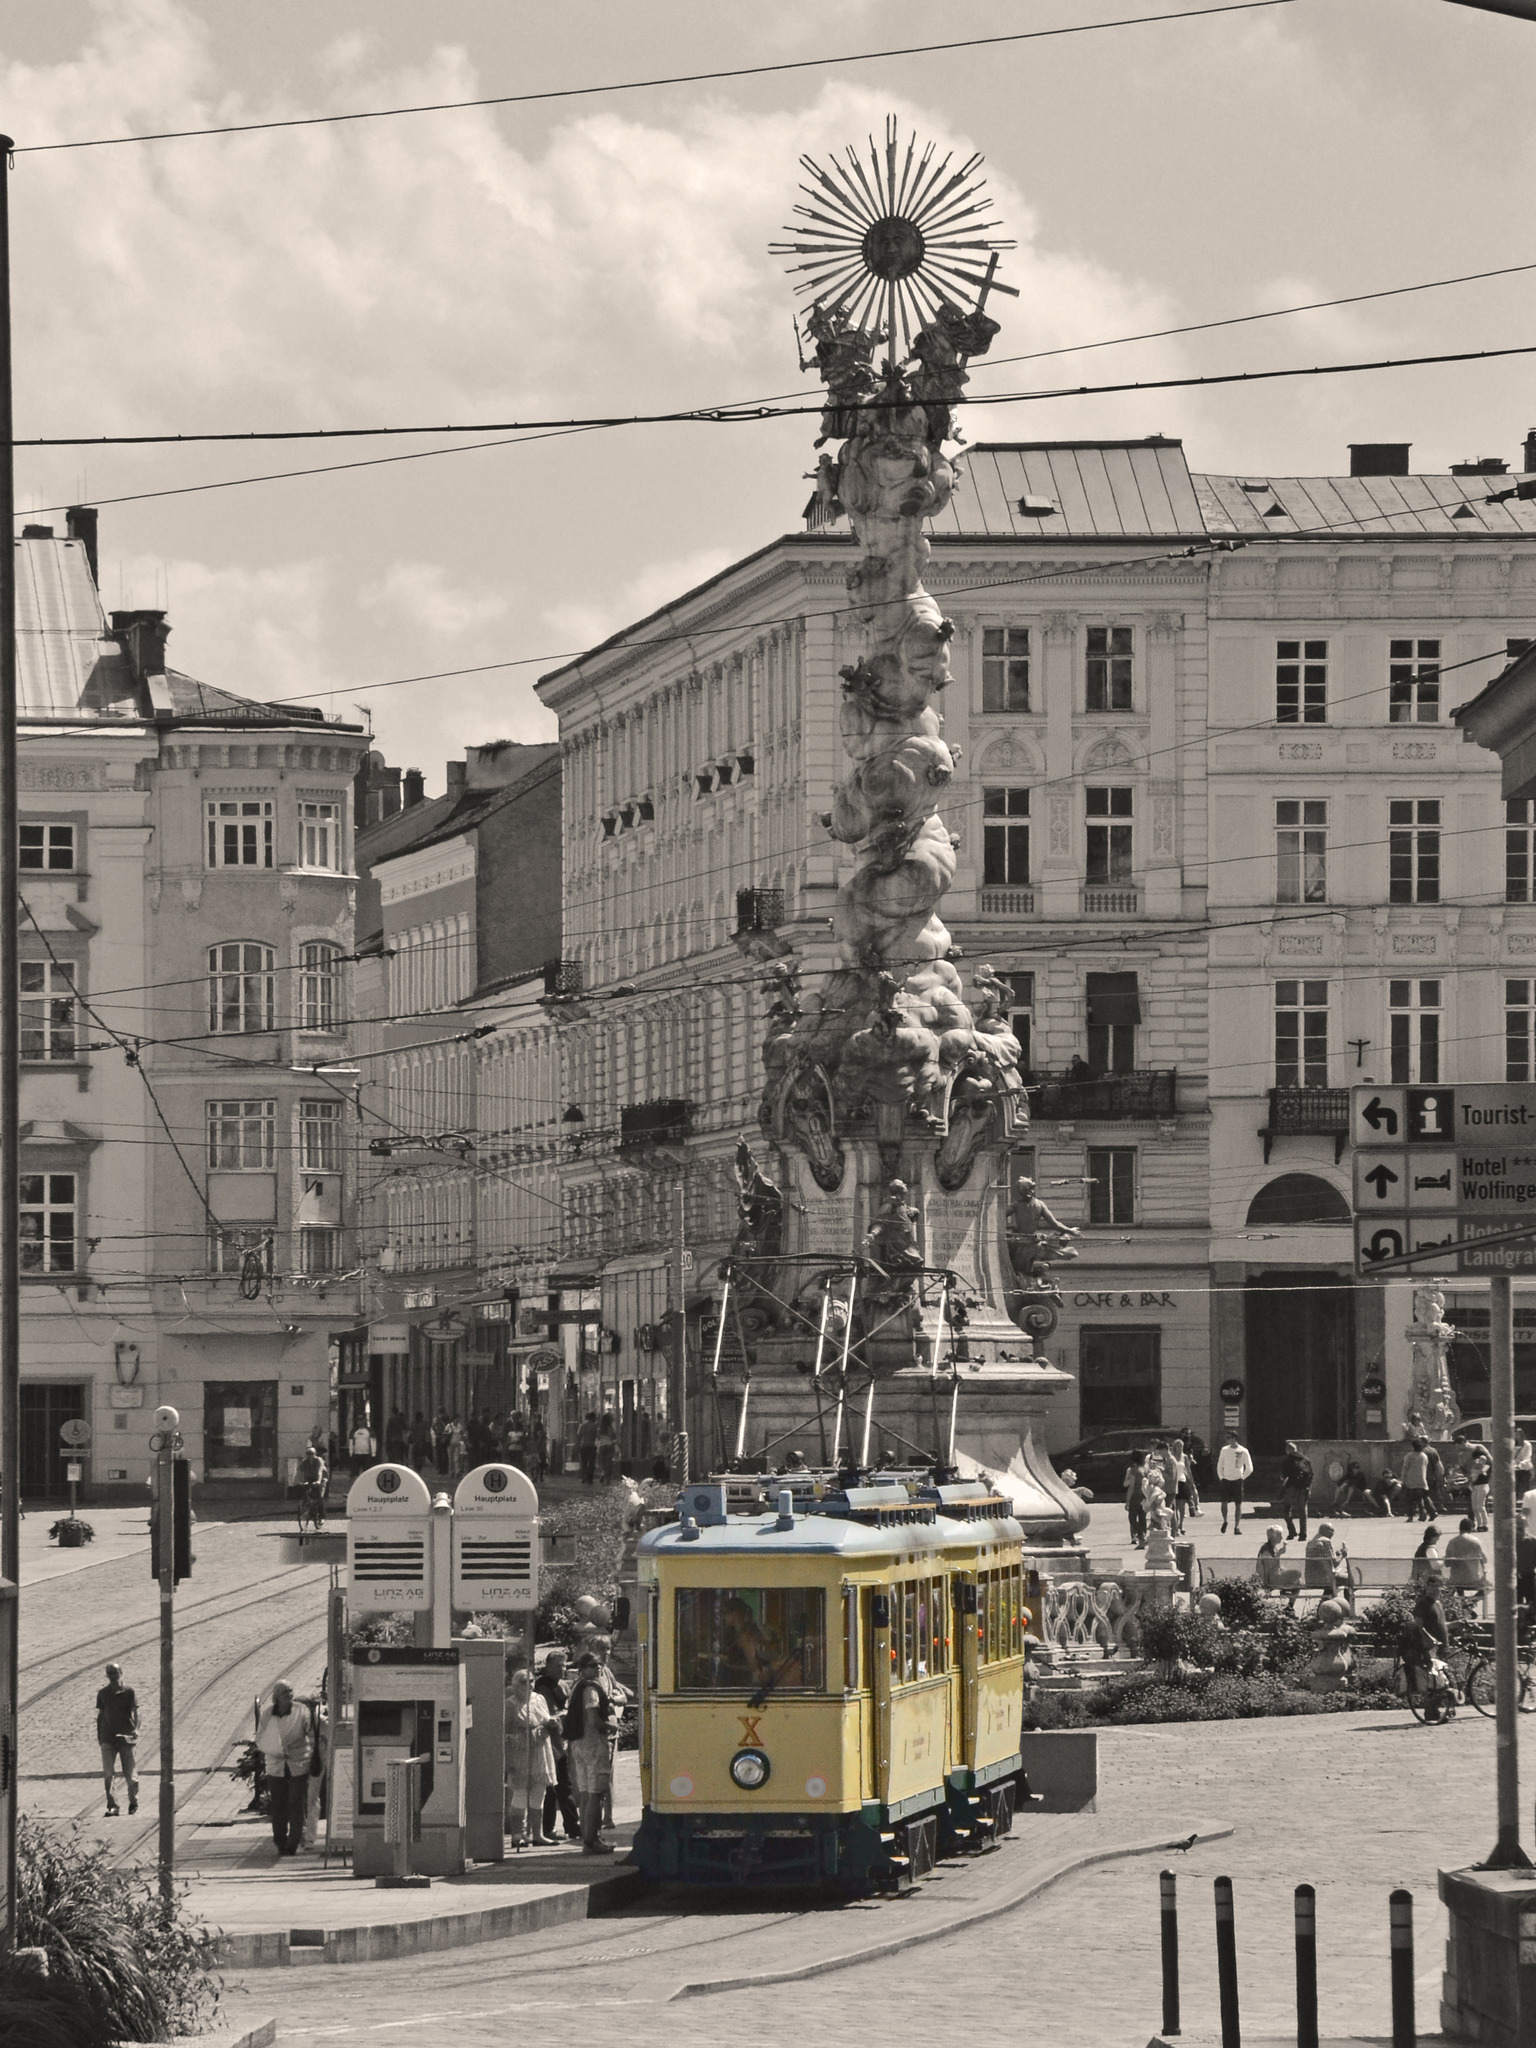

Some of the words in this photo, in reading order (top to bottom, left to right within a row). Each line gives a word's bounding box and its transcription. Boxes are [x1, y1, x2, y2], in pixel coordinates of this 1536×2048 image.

[1461, 1104, 1535, 1126] Tourist-
[1462, 1157, 1507, 1177] Hotel
[1462, 1180, 1536, 1203] Wolfinge
[1120, 1294, 1134, 1307] &
[1140, 1292, 1177, 1308] BAR
[474, 1495, 517, 1503] Hauptplatz
[406, 1588, 424, 1596] AG
[513, 1588, 531, 1596] AG
[737, 1716, 764, 1746] X
